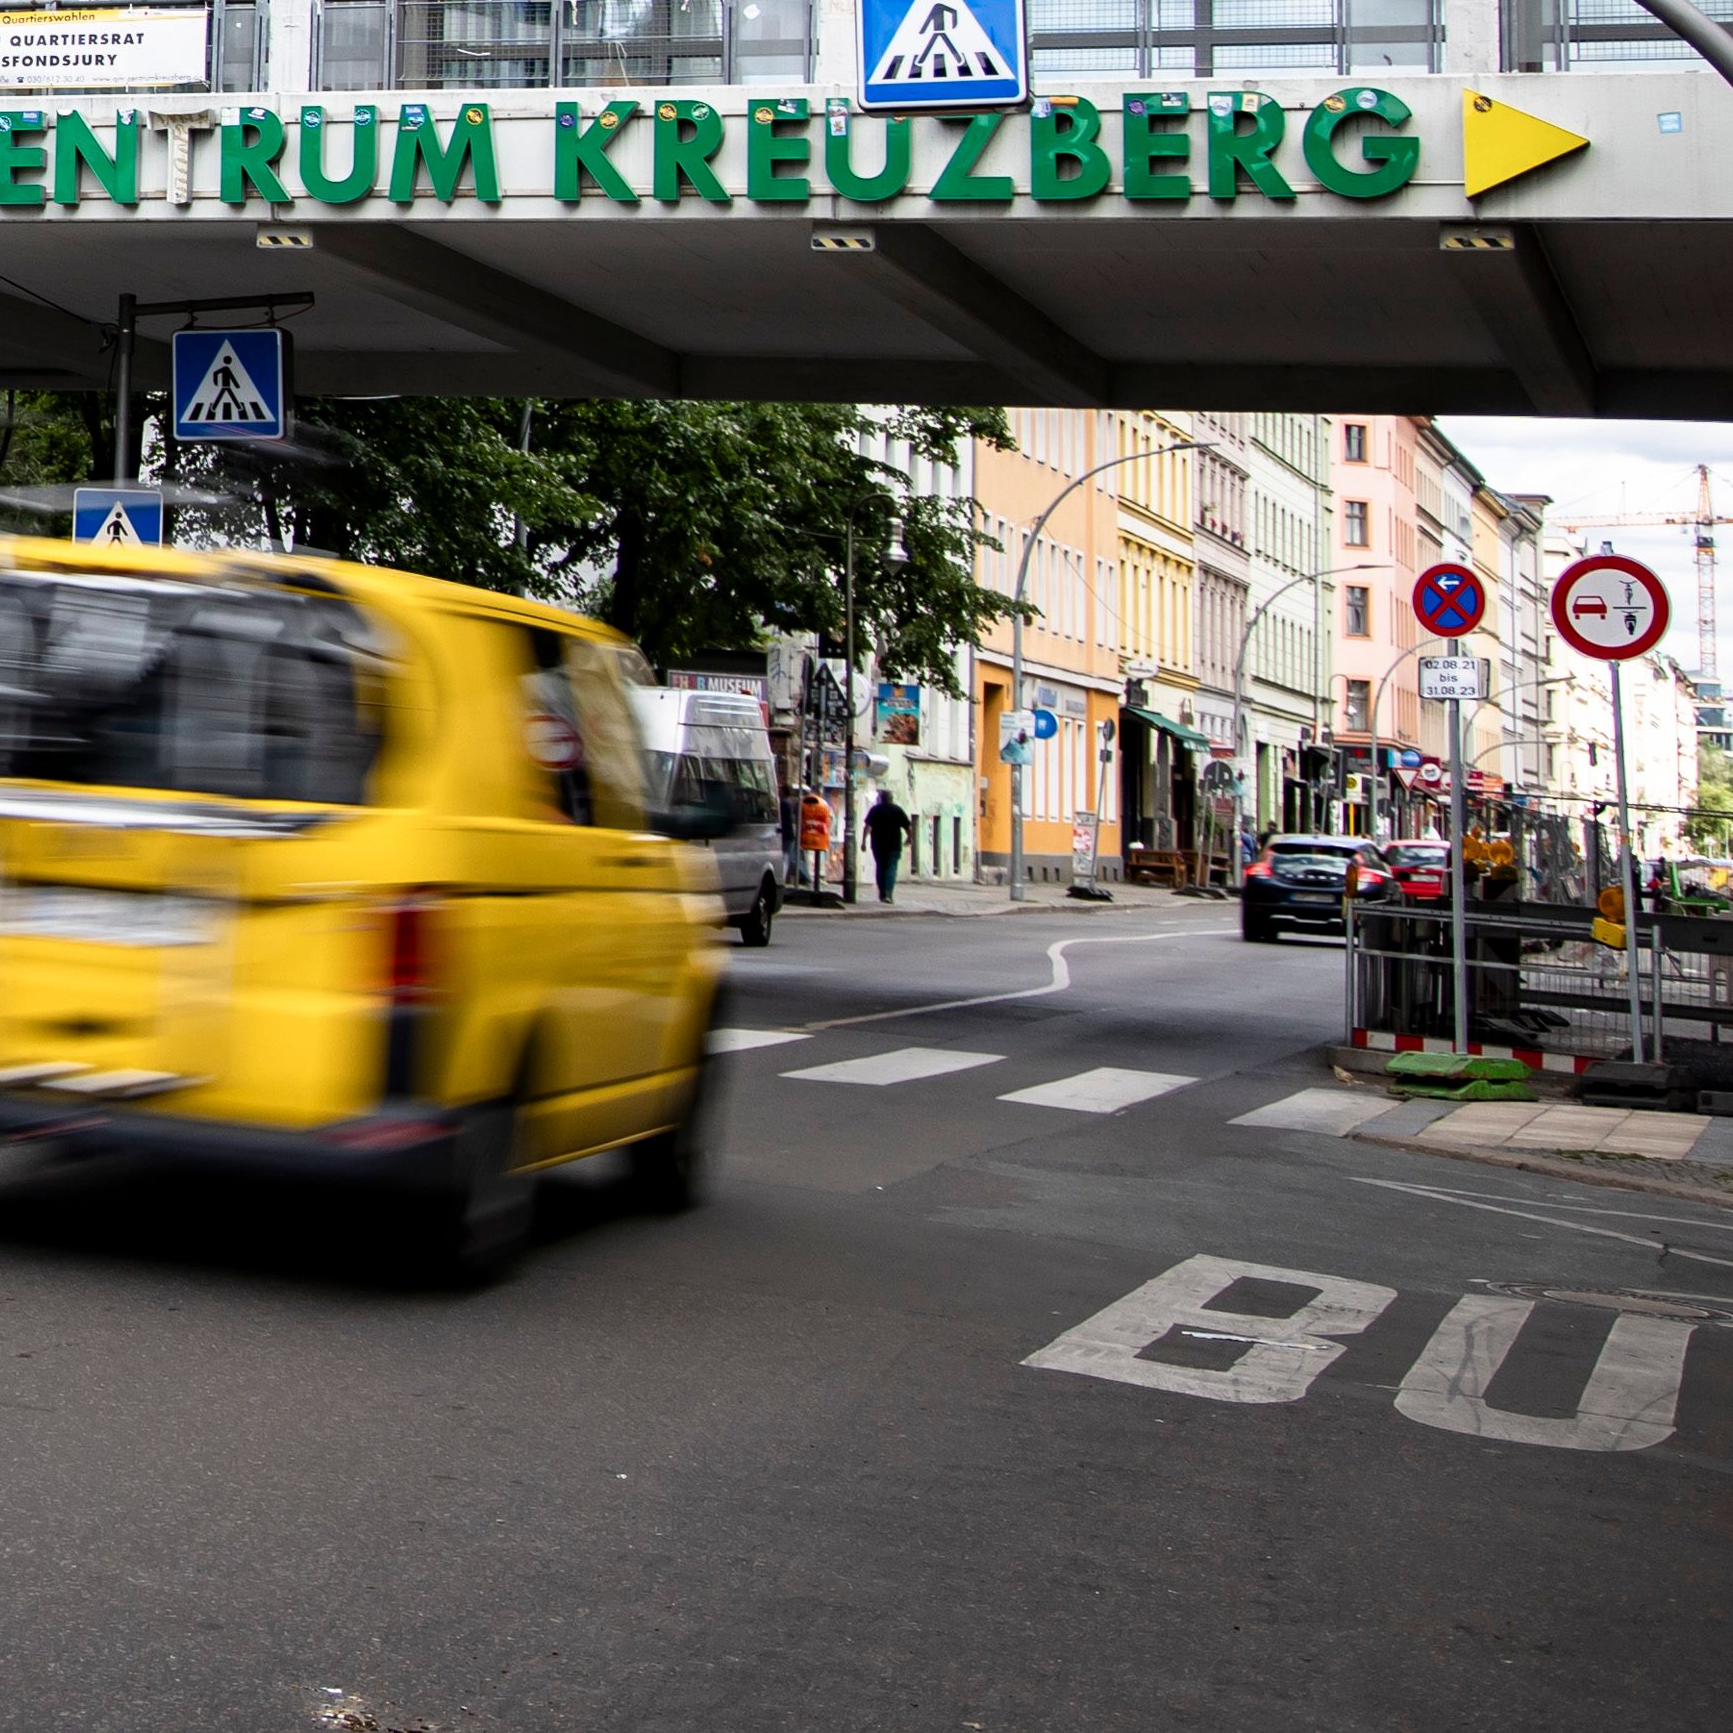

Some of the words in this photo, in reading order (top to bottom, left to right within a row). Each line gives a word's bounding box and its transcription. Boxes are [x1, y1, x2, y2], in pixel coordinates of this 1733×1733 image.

[2, 12, 95, 25] Quartierswahlen
[10, 32, 145, 47] QUARTIERSRAT
[554, 86, 1421, 206] KREUZBERG
[1425, 660, 1475, 670] 02.08.21
[1439, 673, 1458, 682] bis
[707, 677, 762, 696] MUSEUM
[1426, 686, 1476, 696] 31.08.23
[1019, 1253, 1699, 1452] BU
